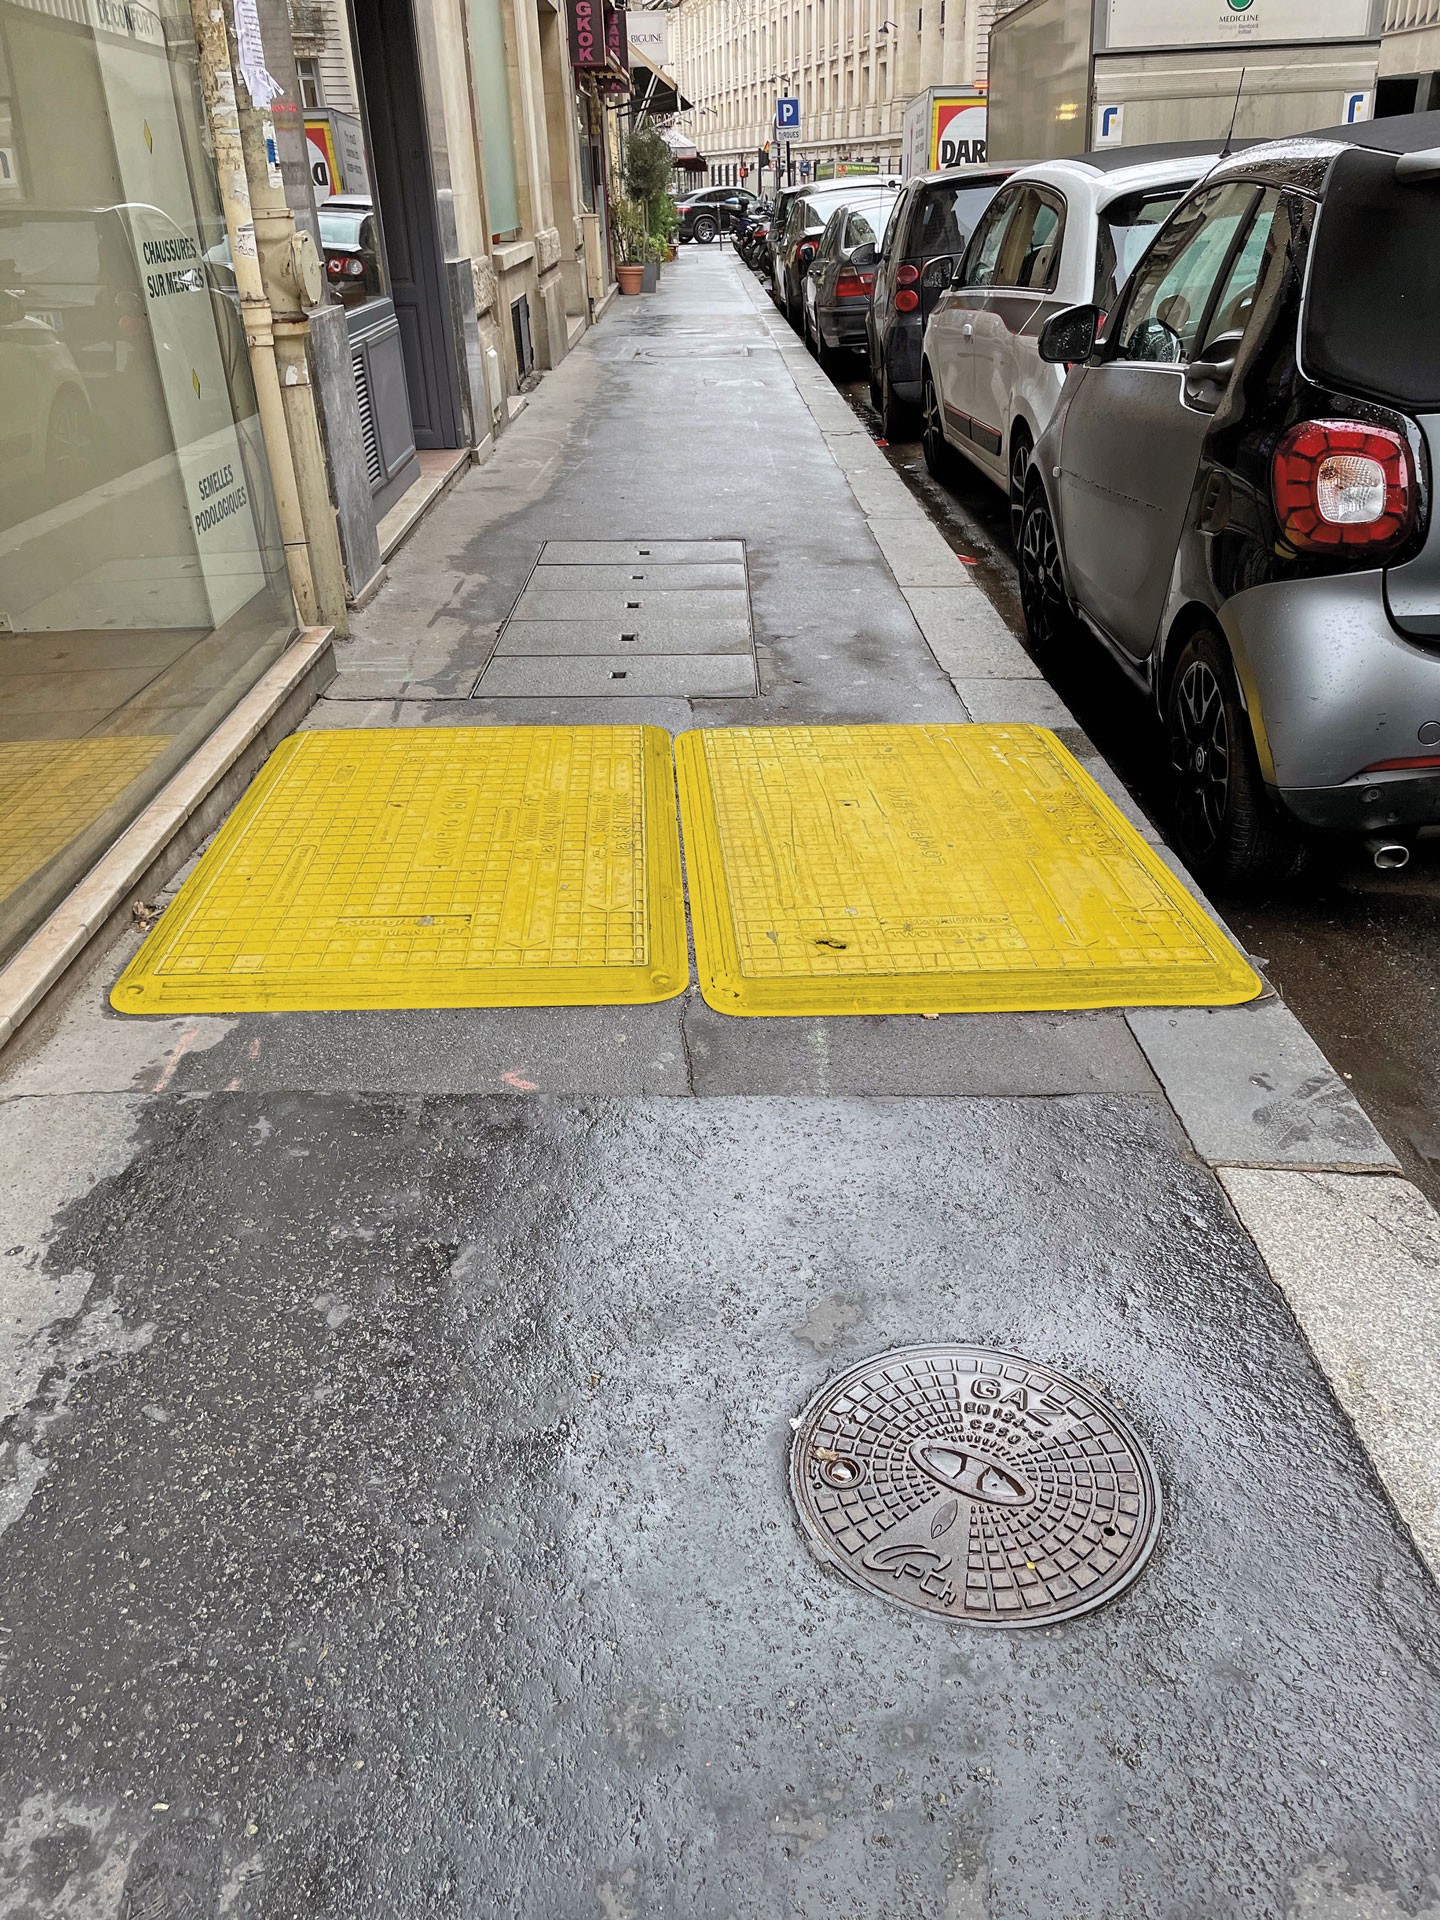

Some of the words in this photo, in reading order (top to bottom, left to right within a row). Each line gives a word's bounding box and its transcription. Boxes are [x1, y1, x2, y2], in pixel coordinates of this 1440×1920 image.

[1219, 14, 1260, 23] MEDICLINE
[630, 33, 663, 43] BIGUINE
[783, 103, 794, 122] P
[143, 237, 197, 265] CHAUSSURES
[147, 273, 167, 298] SUR
[198, 464, 234, 501] SEMELLES
[195, 486, 247, 535] PODOLOGIQUES
[970, 1377, 1067, 1427] GAZ
